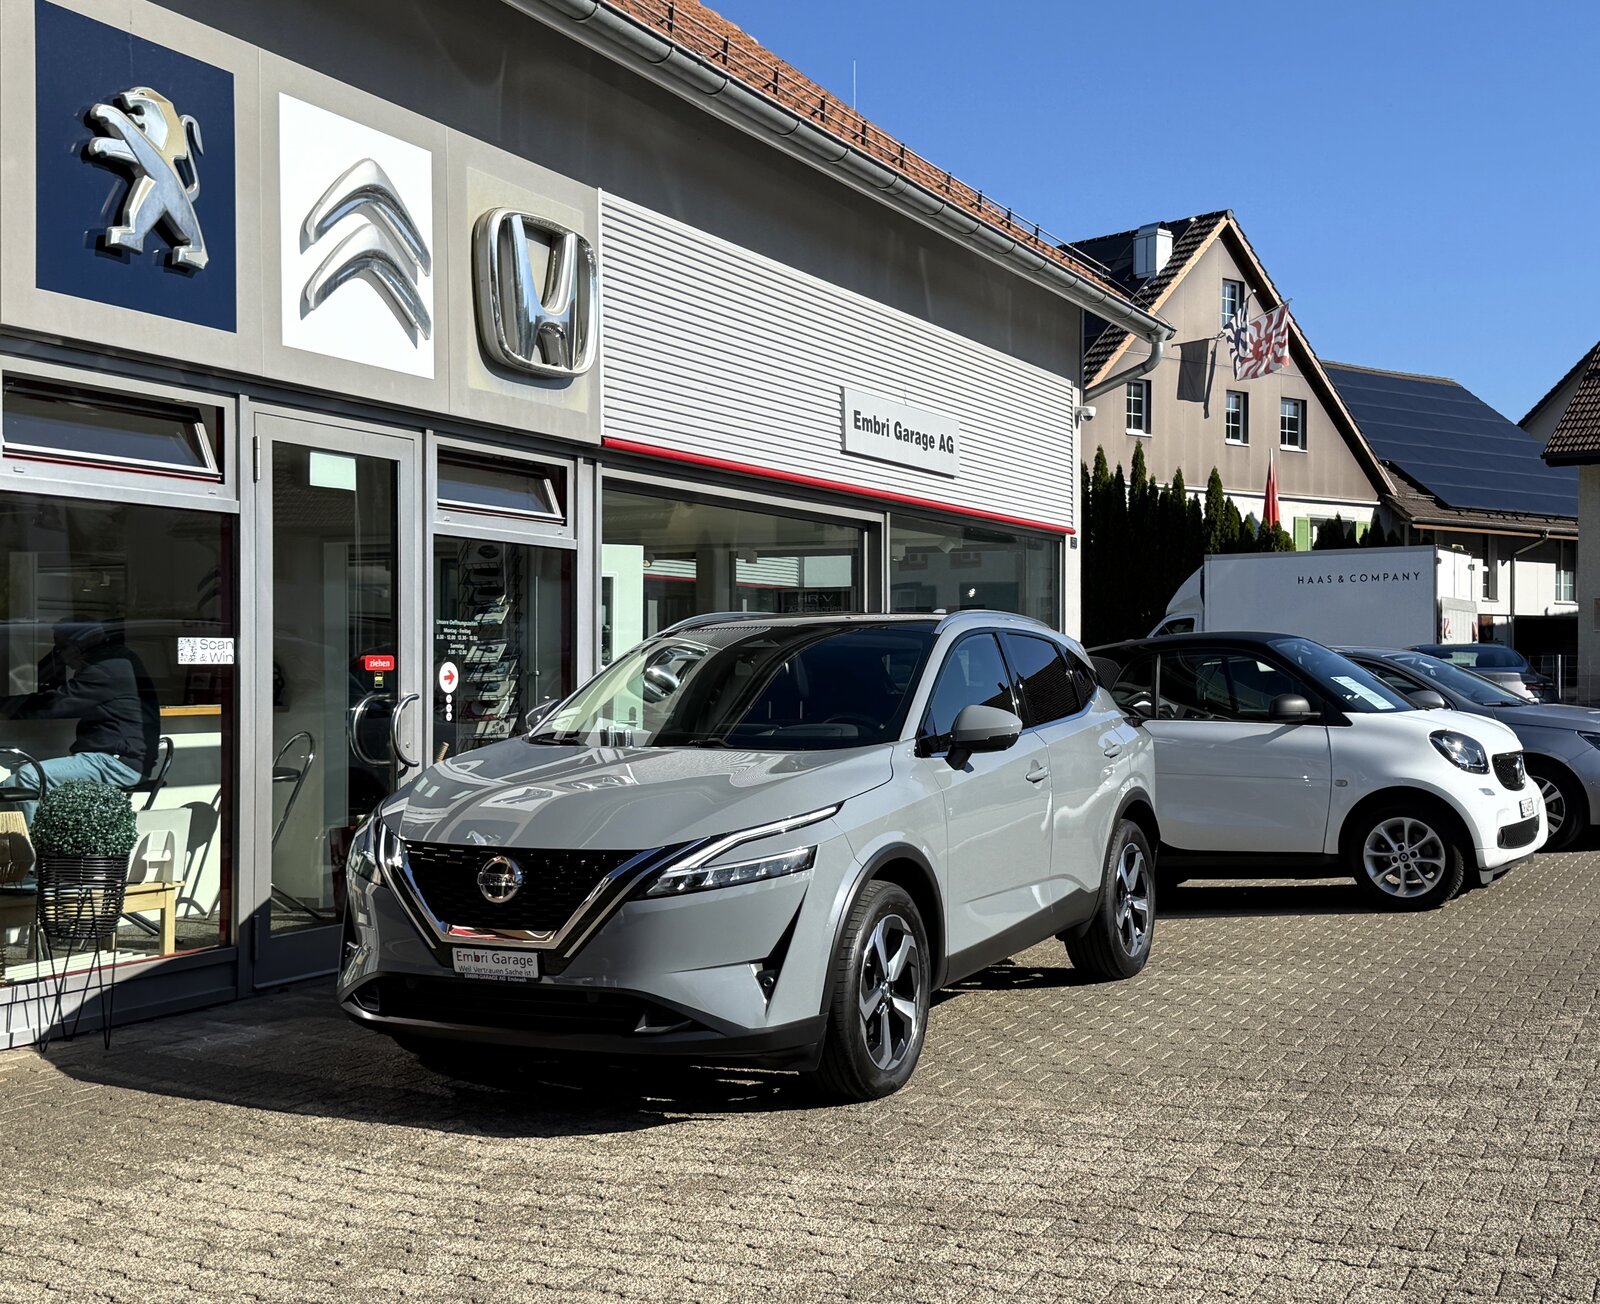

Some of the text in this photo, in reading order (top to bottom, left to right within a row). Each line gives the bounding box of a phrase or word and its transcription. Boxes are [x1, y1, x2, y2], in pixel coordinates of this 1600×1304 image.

[853, 409, 954, 454] Embri Garage AG
[1297, 572, 1420, 584] HAAS & COMPANY
[797, 594, 833, 603] HR-V
[199, 638, 234, 650] Scan
[199, 651, 234, 662] & Win
[369, 659, 391, 667] ziehen
[456, 950, 533, 968] Embri Garage
[473, 966, 504, 975] Vertrauen
